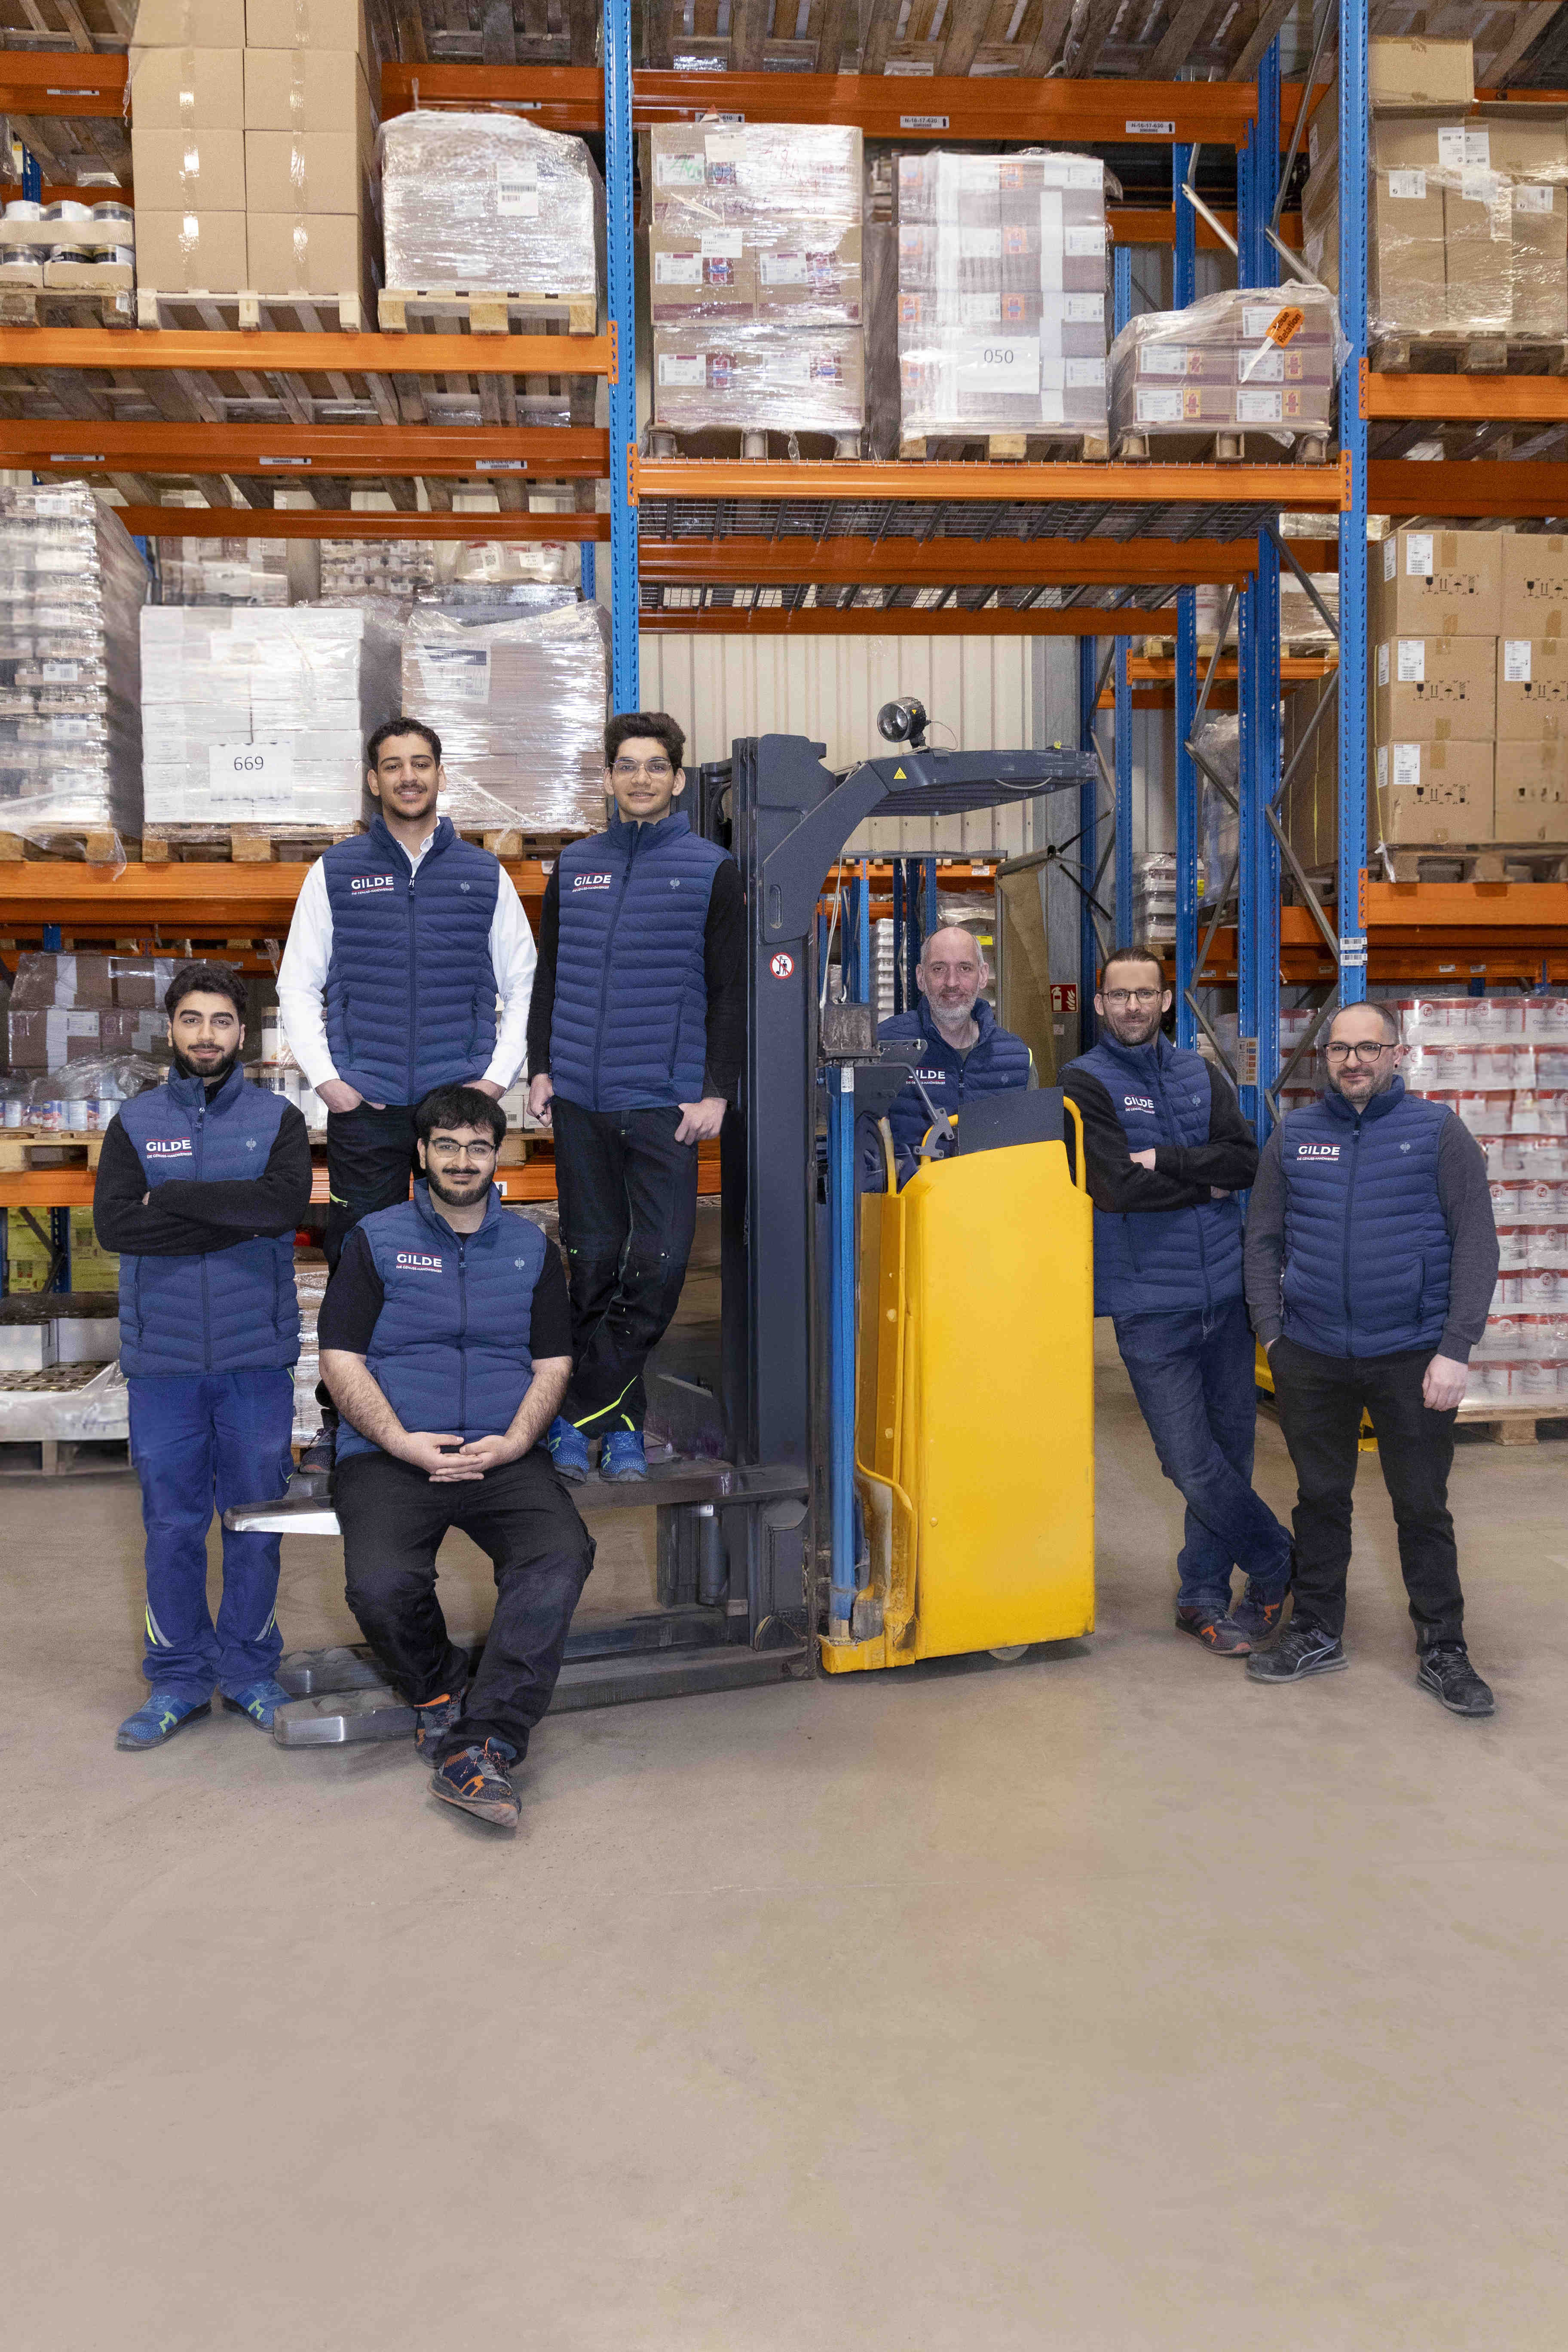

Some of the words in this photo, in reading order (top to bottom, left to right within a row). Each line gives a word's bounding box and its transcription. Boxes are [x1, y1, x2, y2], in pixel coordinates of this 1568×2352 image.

[1277, 313, 1301, 343] Relation
[984, 349, 1014, 364] 050
[234, 756, 263, 771] 669
[351, 876, 394, 890] GILDE
[574, 875, 612, 886] GILDE
[1124, 1096, 1155, 1109] GILDE
[146, 1140, 192, 1152] GILDE
[1298, 1146, 1341, 1155] GILDE
[397, 1254, 442, 1268] GILDE
